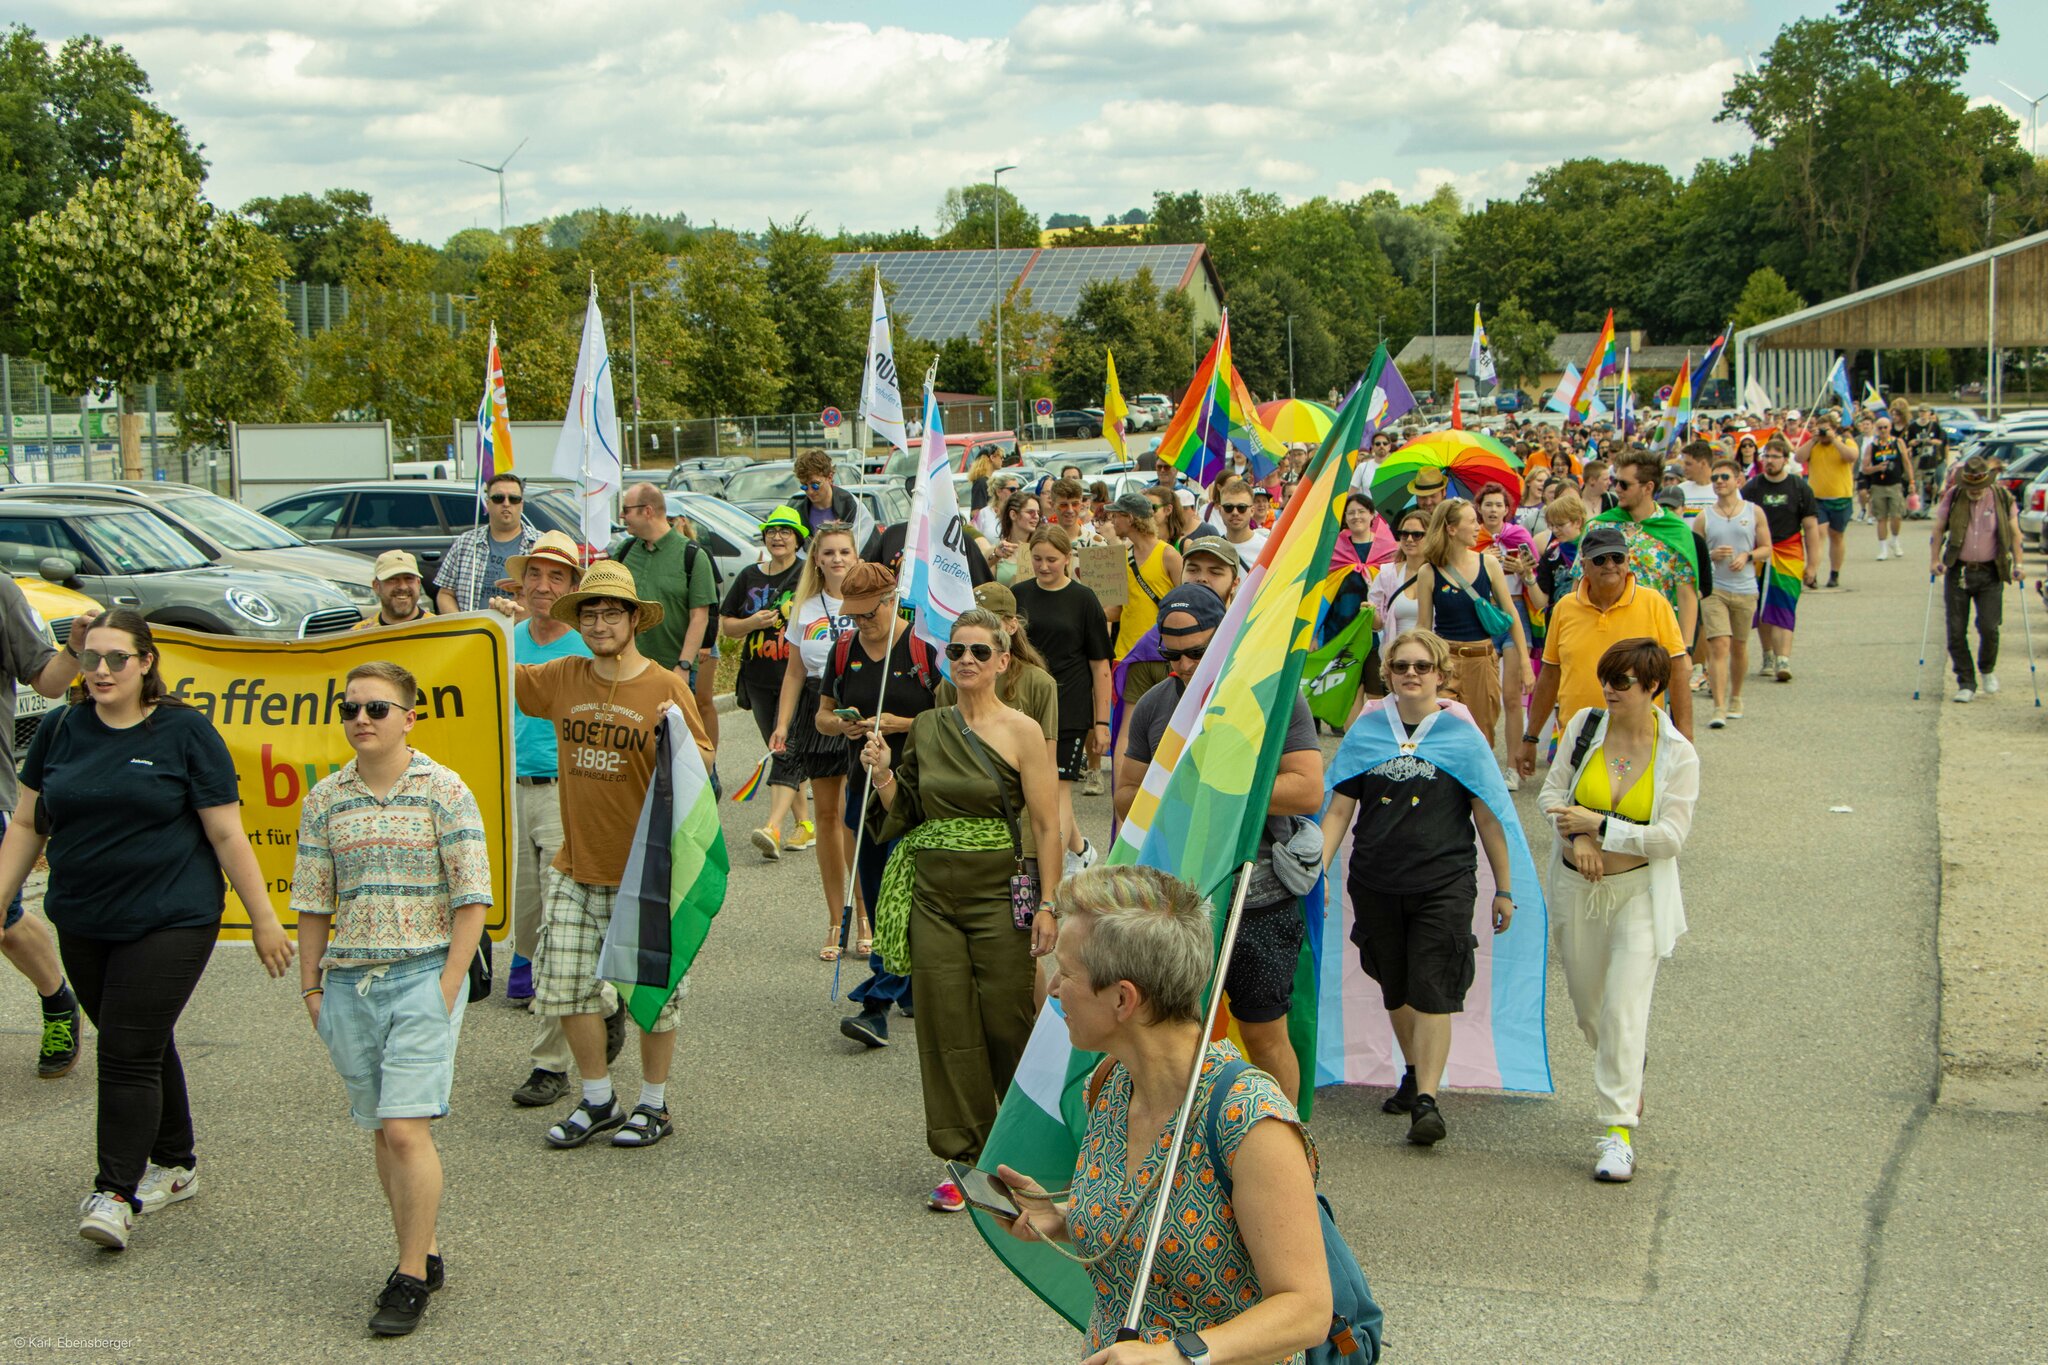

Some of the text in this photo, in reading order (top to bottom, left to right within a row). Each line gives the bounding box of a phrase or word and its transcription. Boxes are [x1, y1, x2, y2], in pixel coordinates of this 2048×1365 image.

[170, 677, 465, 726] faffenhen
[571, 702, 644, 723] ORIGINAL DNIMWEAR
[594, 712, 615, 722] SICE
[563, 718, 649, 753] BOSTON
[266, 828, 292, 845] für
